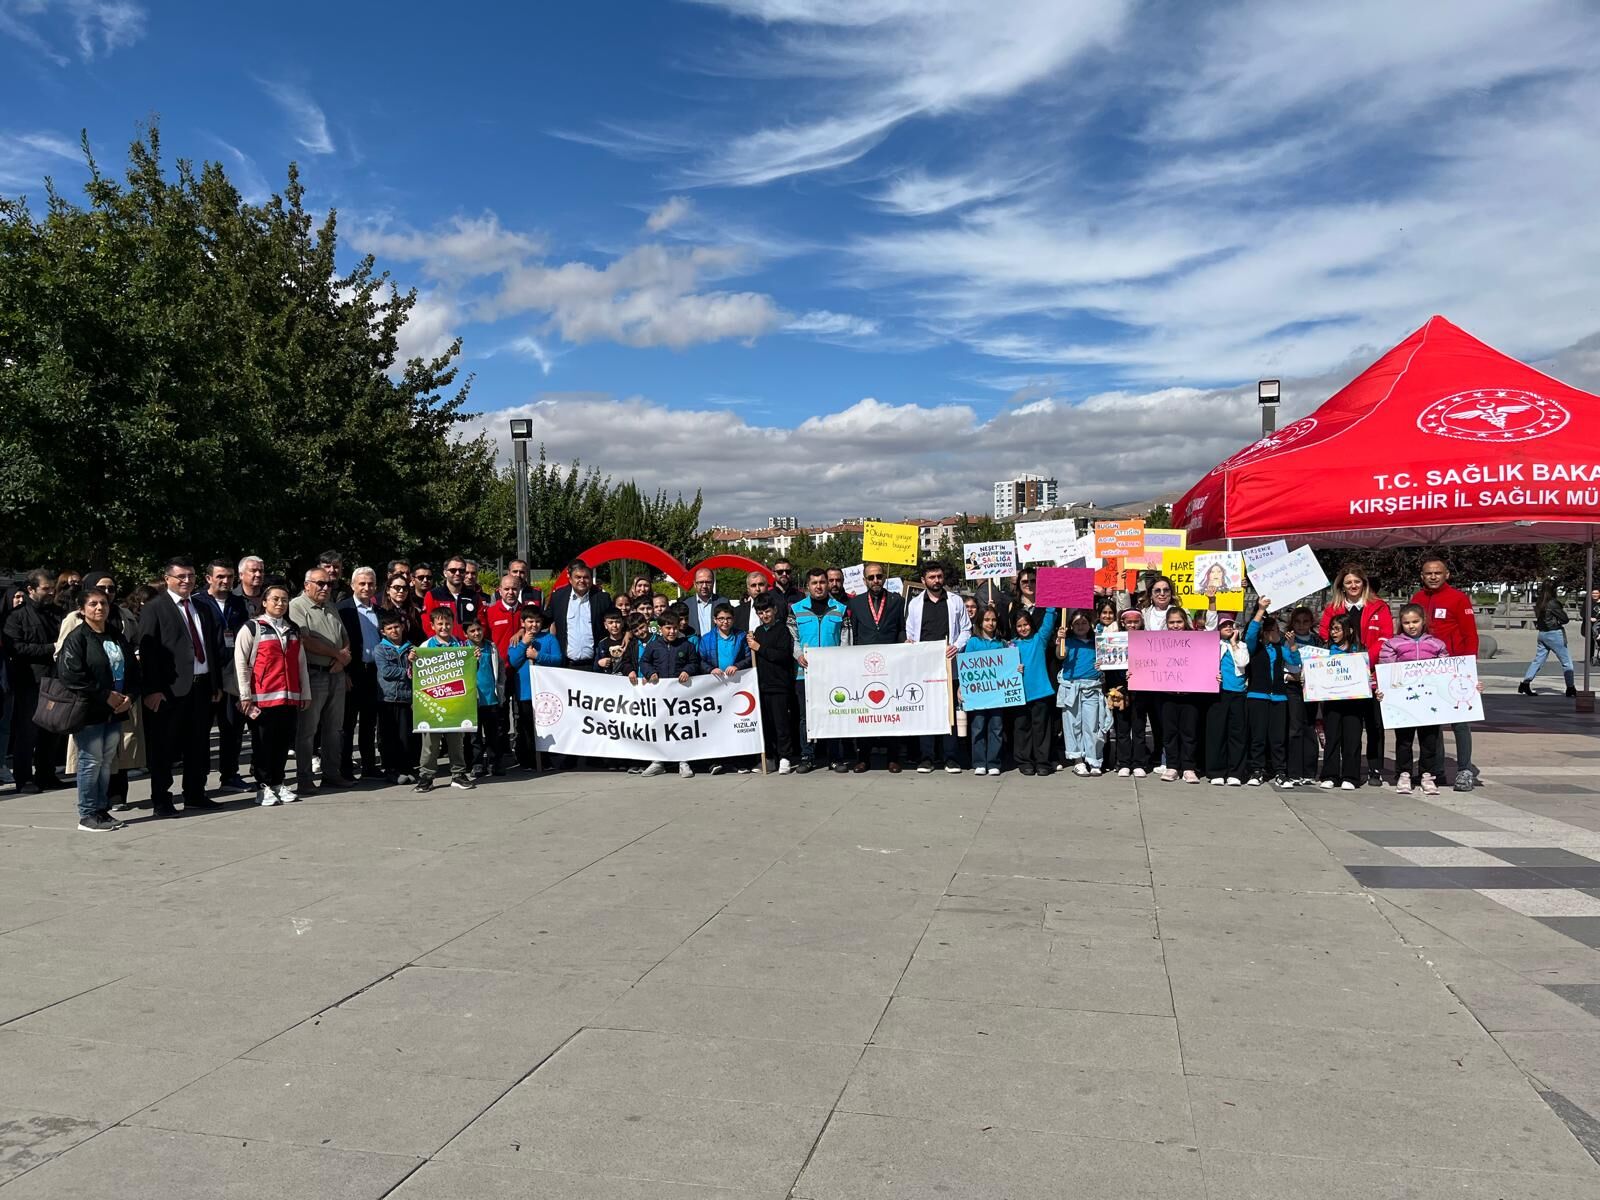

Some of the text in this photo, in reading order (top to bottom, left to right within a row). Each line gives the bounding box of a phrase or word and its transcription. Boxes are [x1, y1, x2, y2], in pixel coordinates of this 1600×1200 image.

[1373, 463, 1600, 490] T.C. SAĞLIK BAKA
[1350, 486, 1599, 516] KIRŞEHİR İL SAĞLIK MÜ
[416, 650, 467, 668] Obezite ile
[418, 659, 465, 678] mücadele
[420, 668, 464, 686] ediyoruz!
[962, 676, 1021, 694] YORULMAZ
[567, 688, 723, 718] Hareketli Yaşa,
[733, 721, 758, 729] KIZILAY
[858, 714, 901, 724] MUTLU YAŞA
[582, 716, 707, 742] Sağlıklı Kal.
